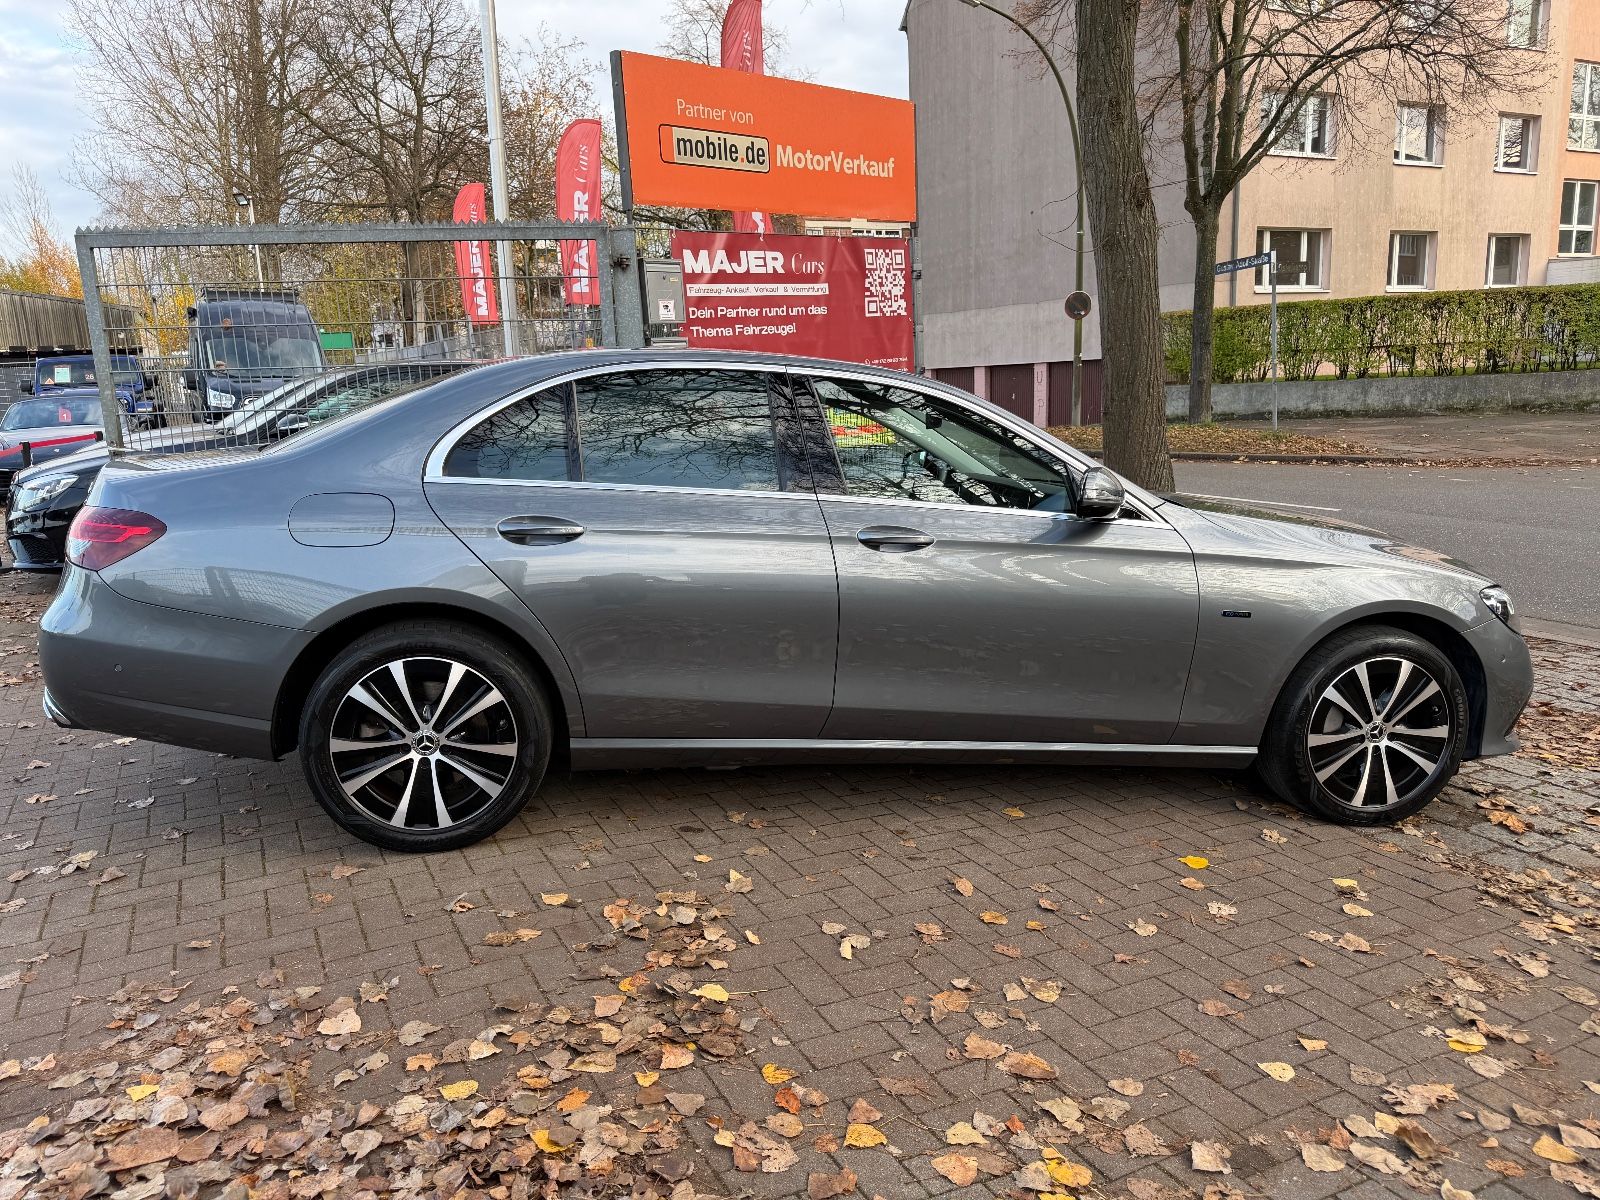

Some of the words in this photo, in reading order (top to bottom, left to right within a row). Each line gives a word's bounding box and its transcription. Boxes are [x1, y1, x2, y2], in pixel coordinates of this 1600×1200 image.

[676, 98, 726, 121] Partner
[729, 109, 754, 125] von
[676, 135, 766, 166] mobile.de
[776, 144, 895, 178] MotorVerkauf
[572, 190, 592, 293] MAER
[682, 249, 785, 274] MAJER
[791, 252, 825, 275] Cars
[688, 286, 724, 295] Fahrzeug-
[753, 285, 780, 293] Verkauf
[688, 306, 715, 319] Dein
[717, 306, 760, 318] Partner
[762, 305, 787, 316] rund
[788, 306, 806, 316] um
[807, 304, 828, 315] das
[690, 326, 733, 338] Thema
